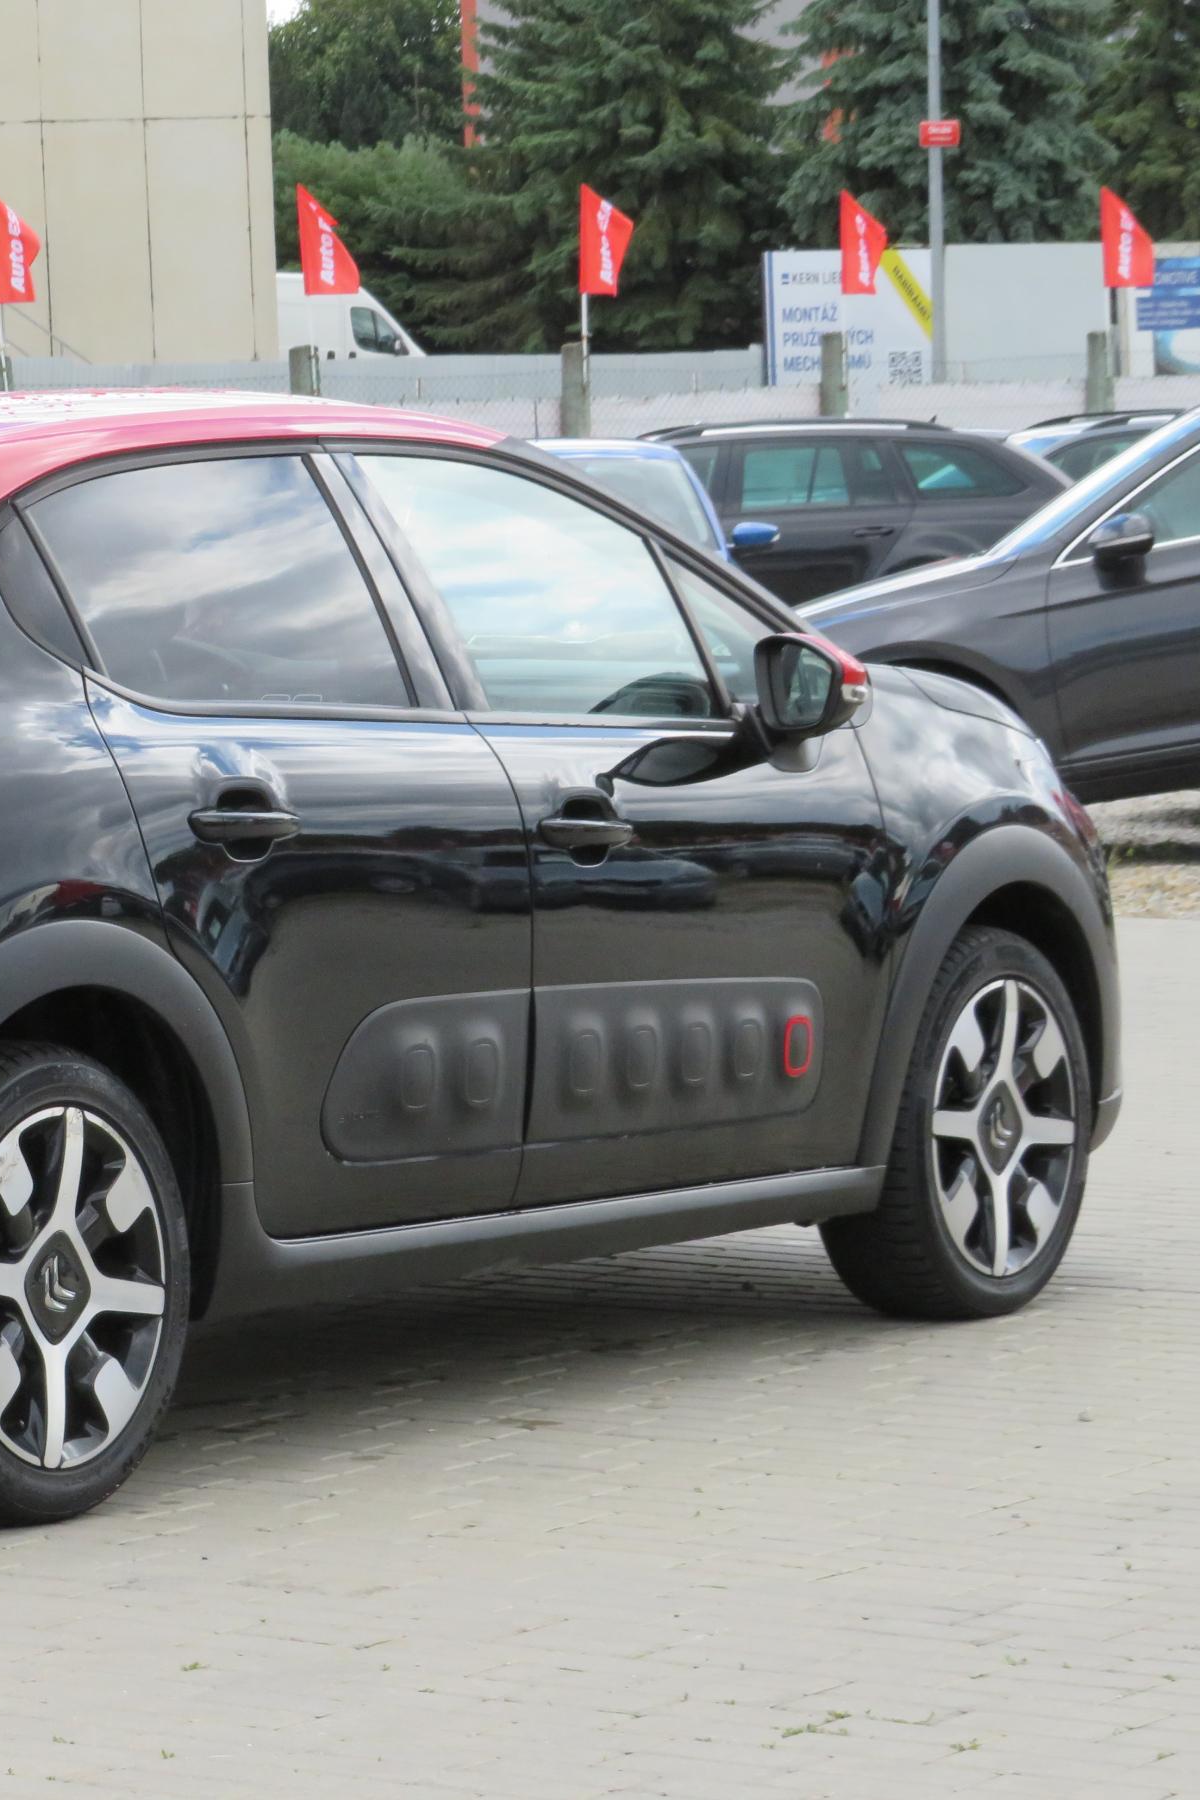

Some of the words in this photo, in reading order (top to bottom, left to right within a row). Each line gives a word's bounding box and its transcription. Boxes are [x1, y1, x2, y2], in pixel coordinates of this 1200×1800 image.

[9, 238, 26, 294] Auto
[320, 232, 336, 287] Auto
[1118, 232, 1133, 280] Auto
[782, 303, 839, 322] MONTÁŽ
